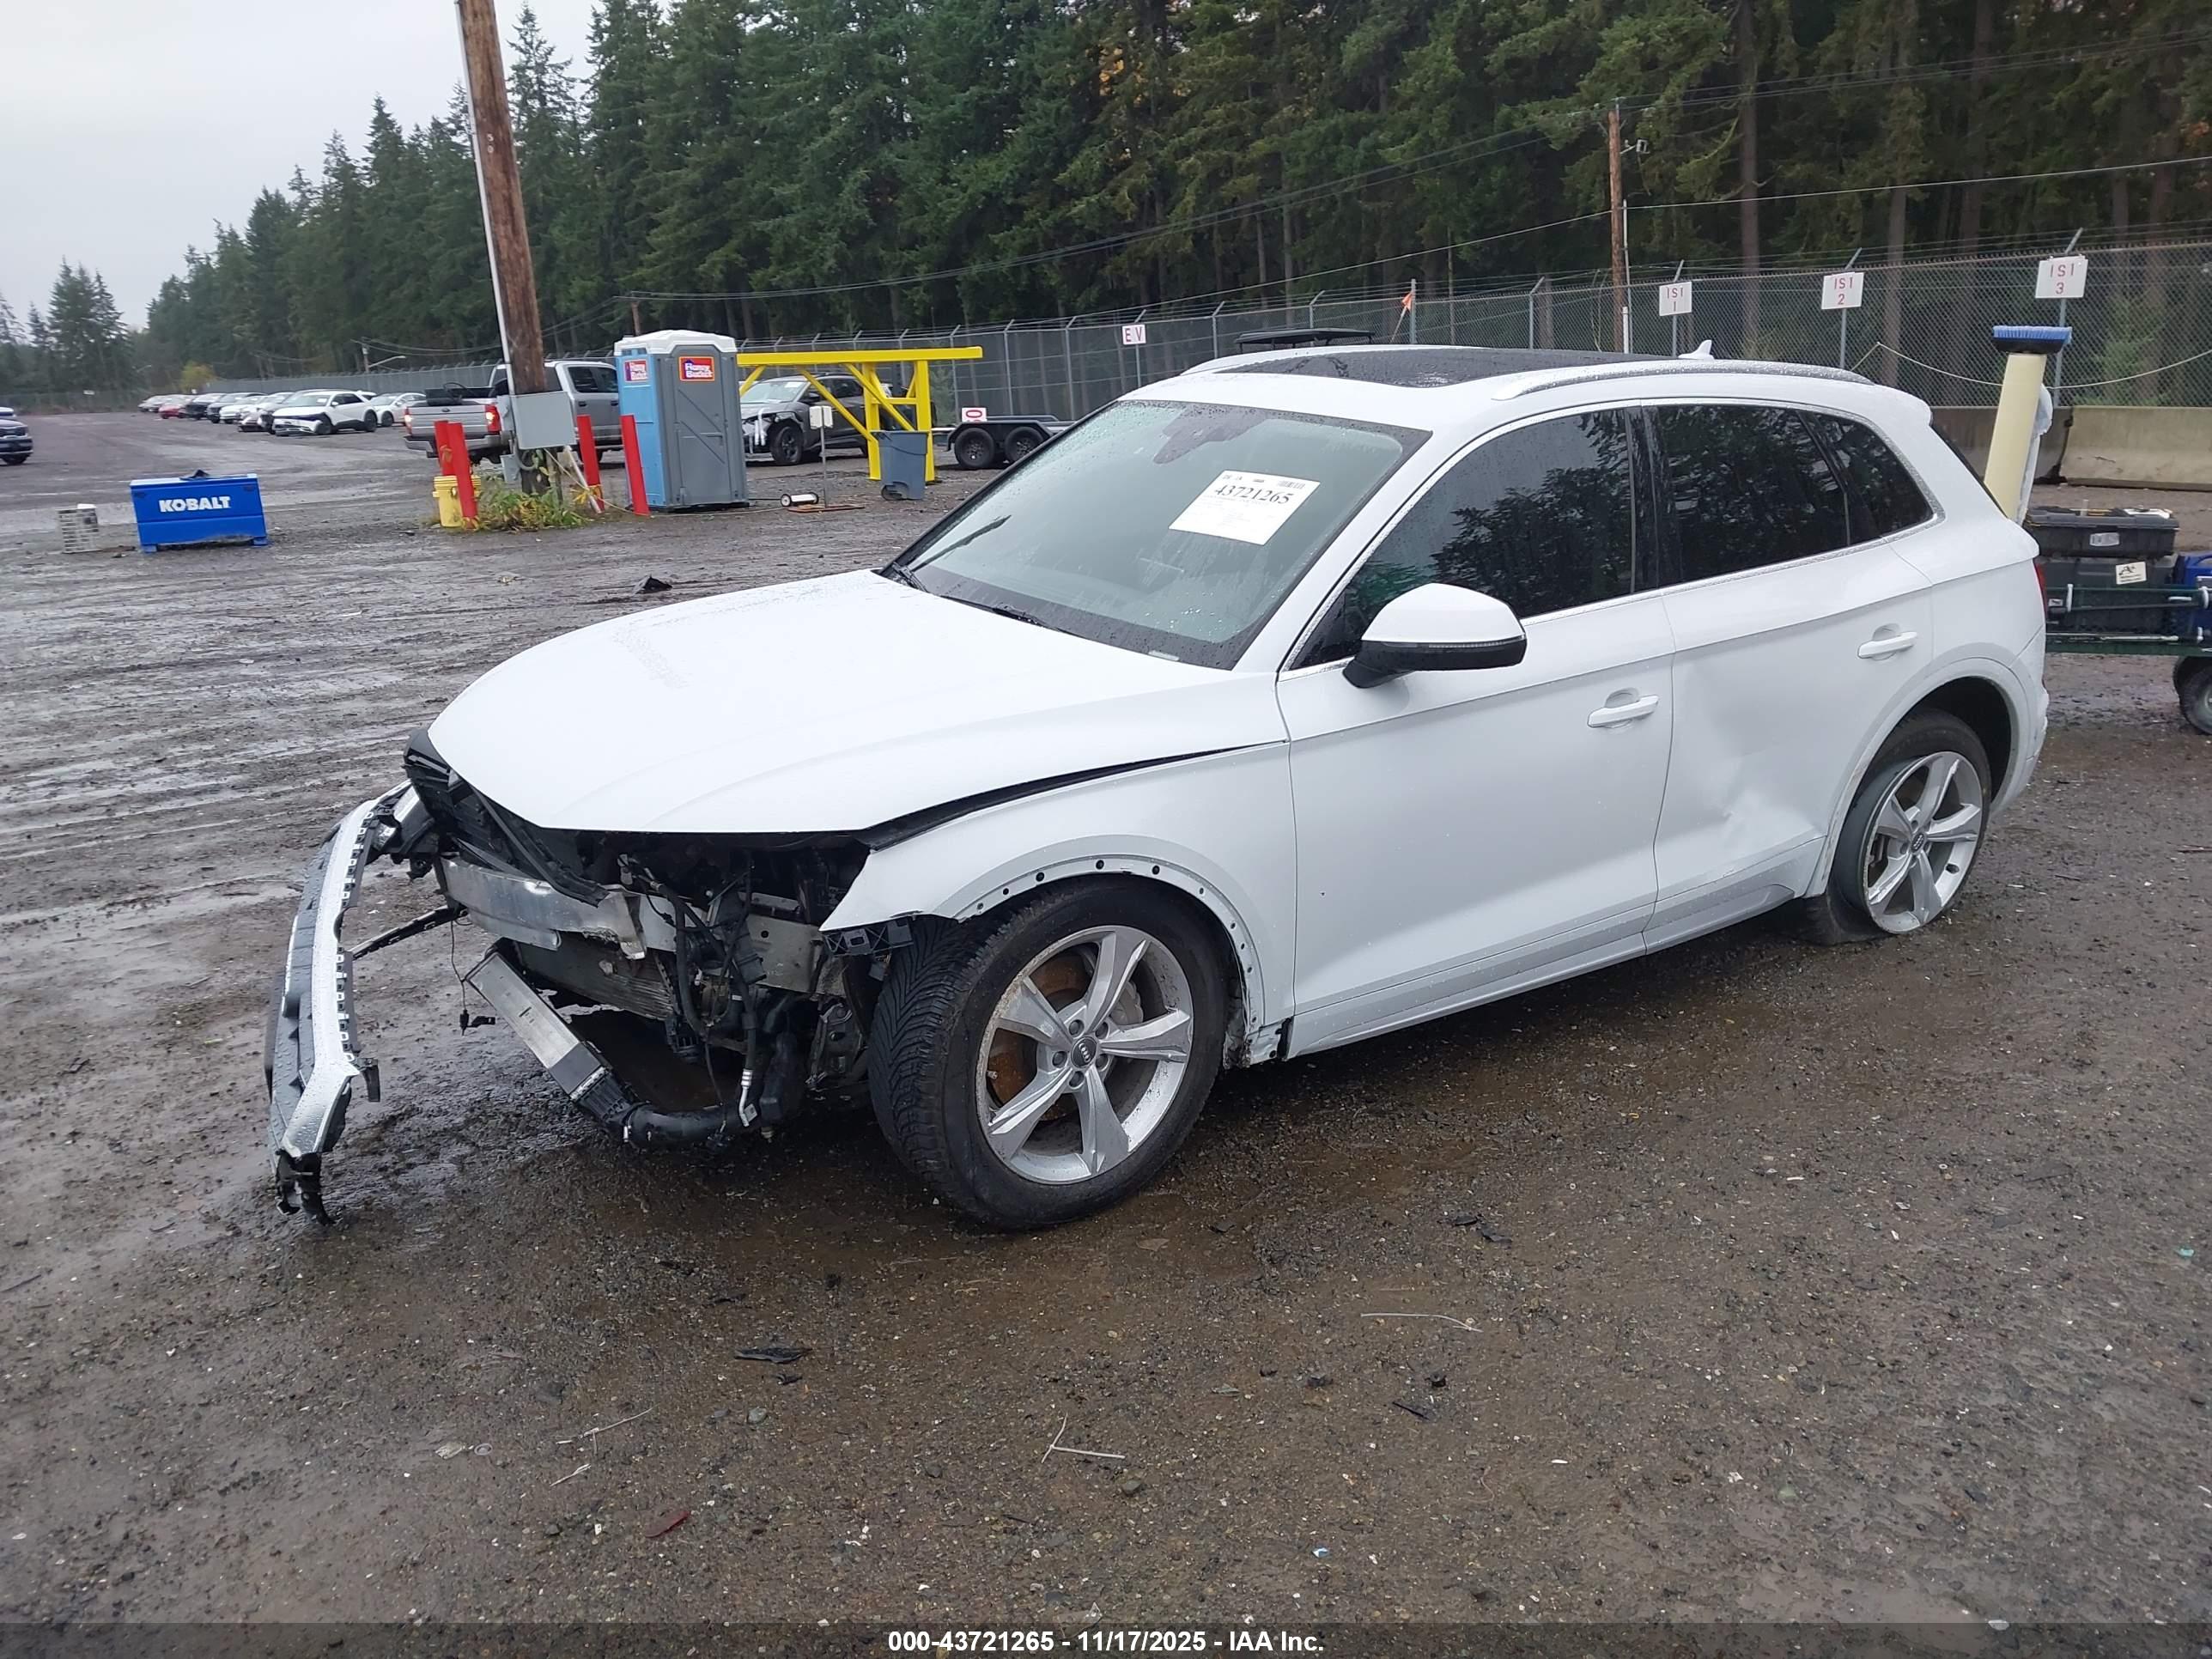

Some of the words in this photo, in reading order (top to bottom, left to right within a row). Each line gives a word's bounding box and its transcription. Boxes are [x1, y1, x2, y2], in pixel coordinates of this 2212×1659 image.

[2055, 282, 2064, 295] 3
[1838, 294, 1845, 305] 2
[1125, 326, 1142, 342] EV
[1214, 484, 1294, 504] 43721265
[158, 496, 231, 513] KOBALT
